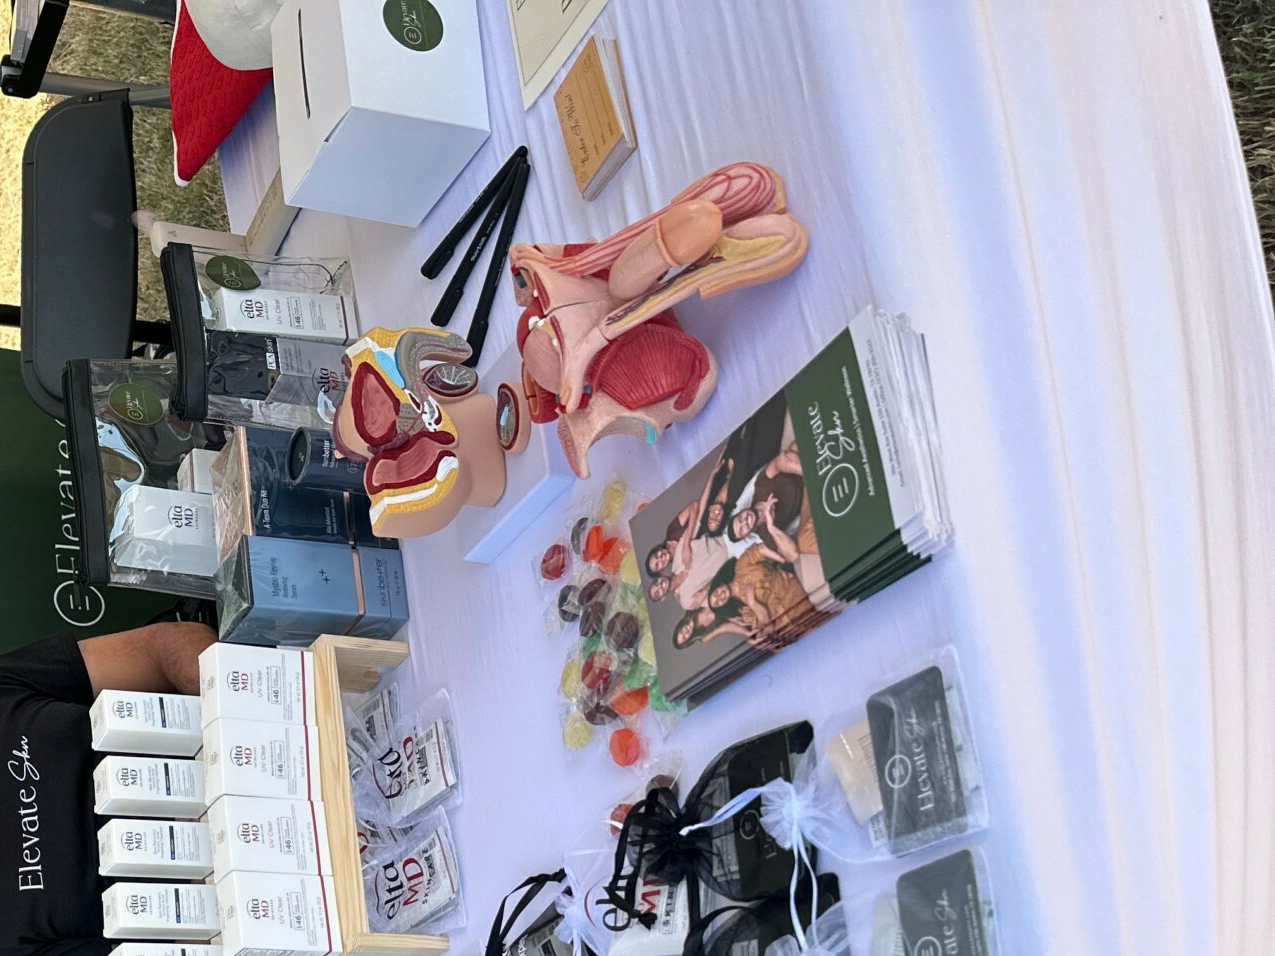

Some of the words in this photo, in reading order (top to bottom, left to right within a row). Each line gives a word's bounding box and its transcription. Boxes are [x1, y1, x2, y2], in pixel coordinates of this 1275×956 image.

[243, 299, 255, 319] elta
[255, 302, 265, 318] MD
[266, 339, 274, 353] skin
[267, 354, 275, 367] PCA
[317, 368, 330, 393] elta
[330, 371, 341, 391] MD
[807, 401, 832, 475] Elevate
[171, 506, 183, 528] elta
[185, 508, 193, 527] MD
[229, 671, 241, 691] elta
[241, 673, 249, 690] MD
[115, 701, 125, 718] elta
[126, 703, 133, 717] MD
[232, 746, 243, 766] elta
[244, 748, 252, 765] MD
[120, 768, 130, 786] elta
[130, 770, 138, 785] MD
[909, 742, 934, 811] Elevate
[15, 786, 45, 891] Elevate
[124, 832, 134, 851] elta
[135, 833, 142, 850] MD
[239, 823, 251, 843] elta
[251, 825, 260, 842] MD
[382, 860, 403, 920] elta
[401, 857, 424, 907] MD
[130, 895, 139, 914] elta
[140, 896, 147, 913] MD
[249, 899, 260, 919] elta
[261, 900, 269, 918] MD
